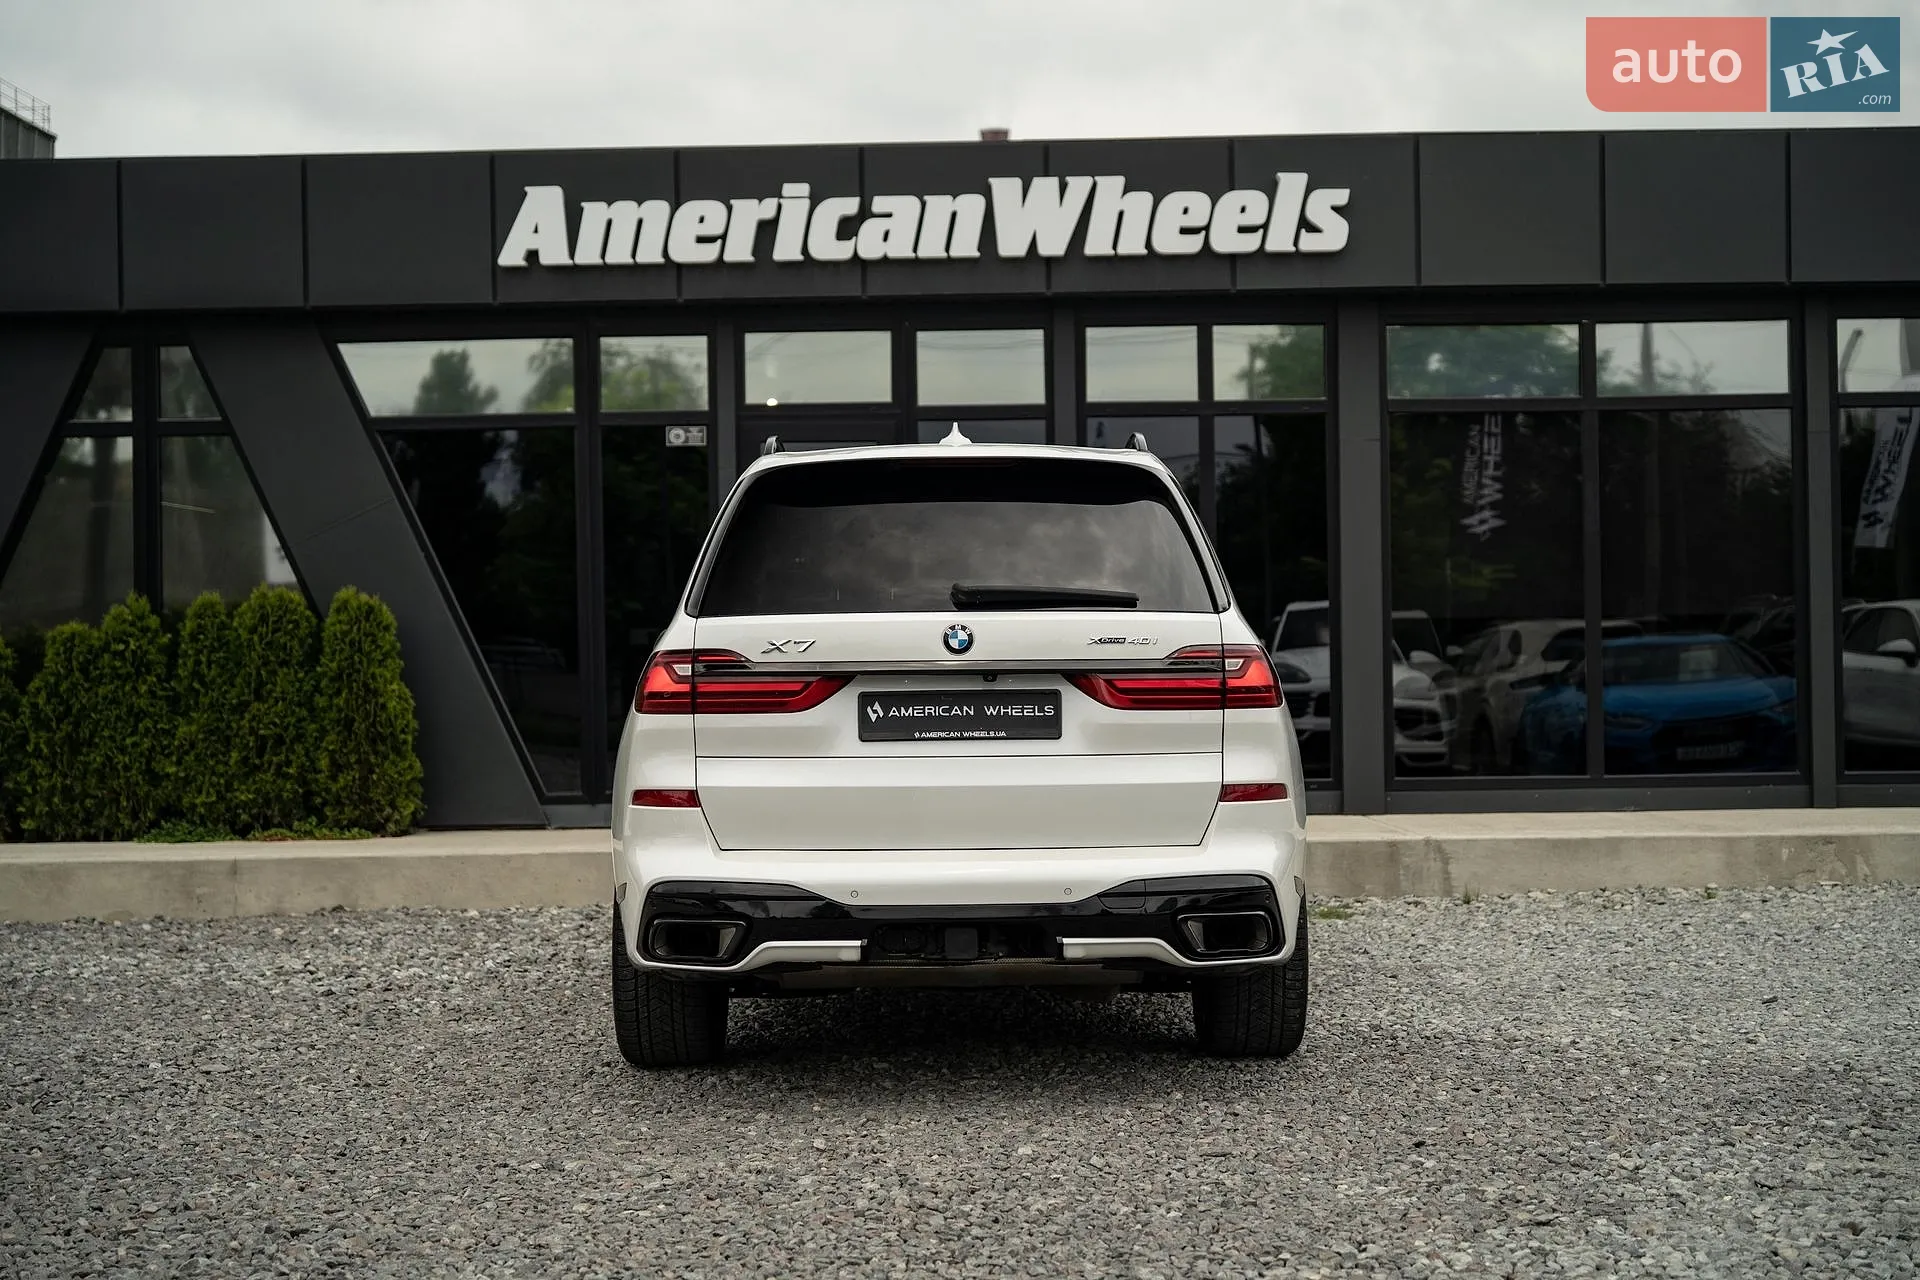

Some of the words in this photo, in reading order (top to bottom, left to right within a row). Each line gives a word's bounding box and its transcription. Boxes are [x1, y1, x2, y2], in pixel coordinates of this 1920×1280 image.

[497, 172, 1349, 266] AmericanWheels
[760, 639, 816, 653] X7
[888, 705, 974, 717] AMERICAN
[984, 705, 1055, 716] WHEELS
